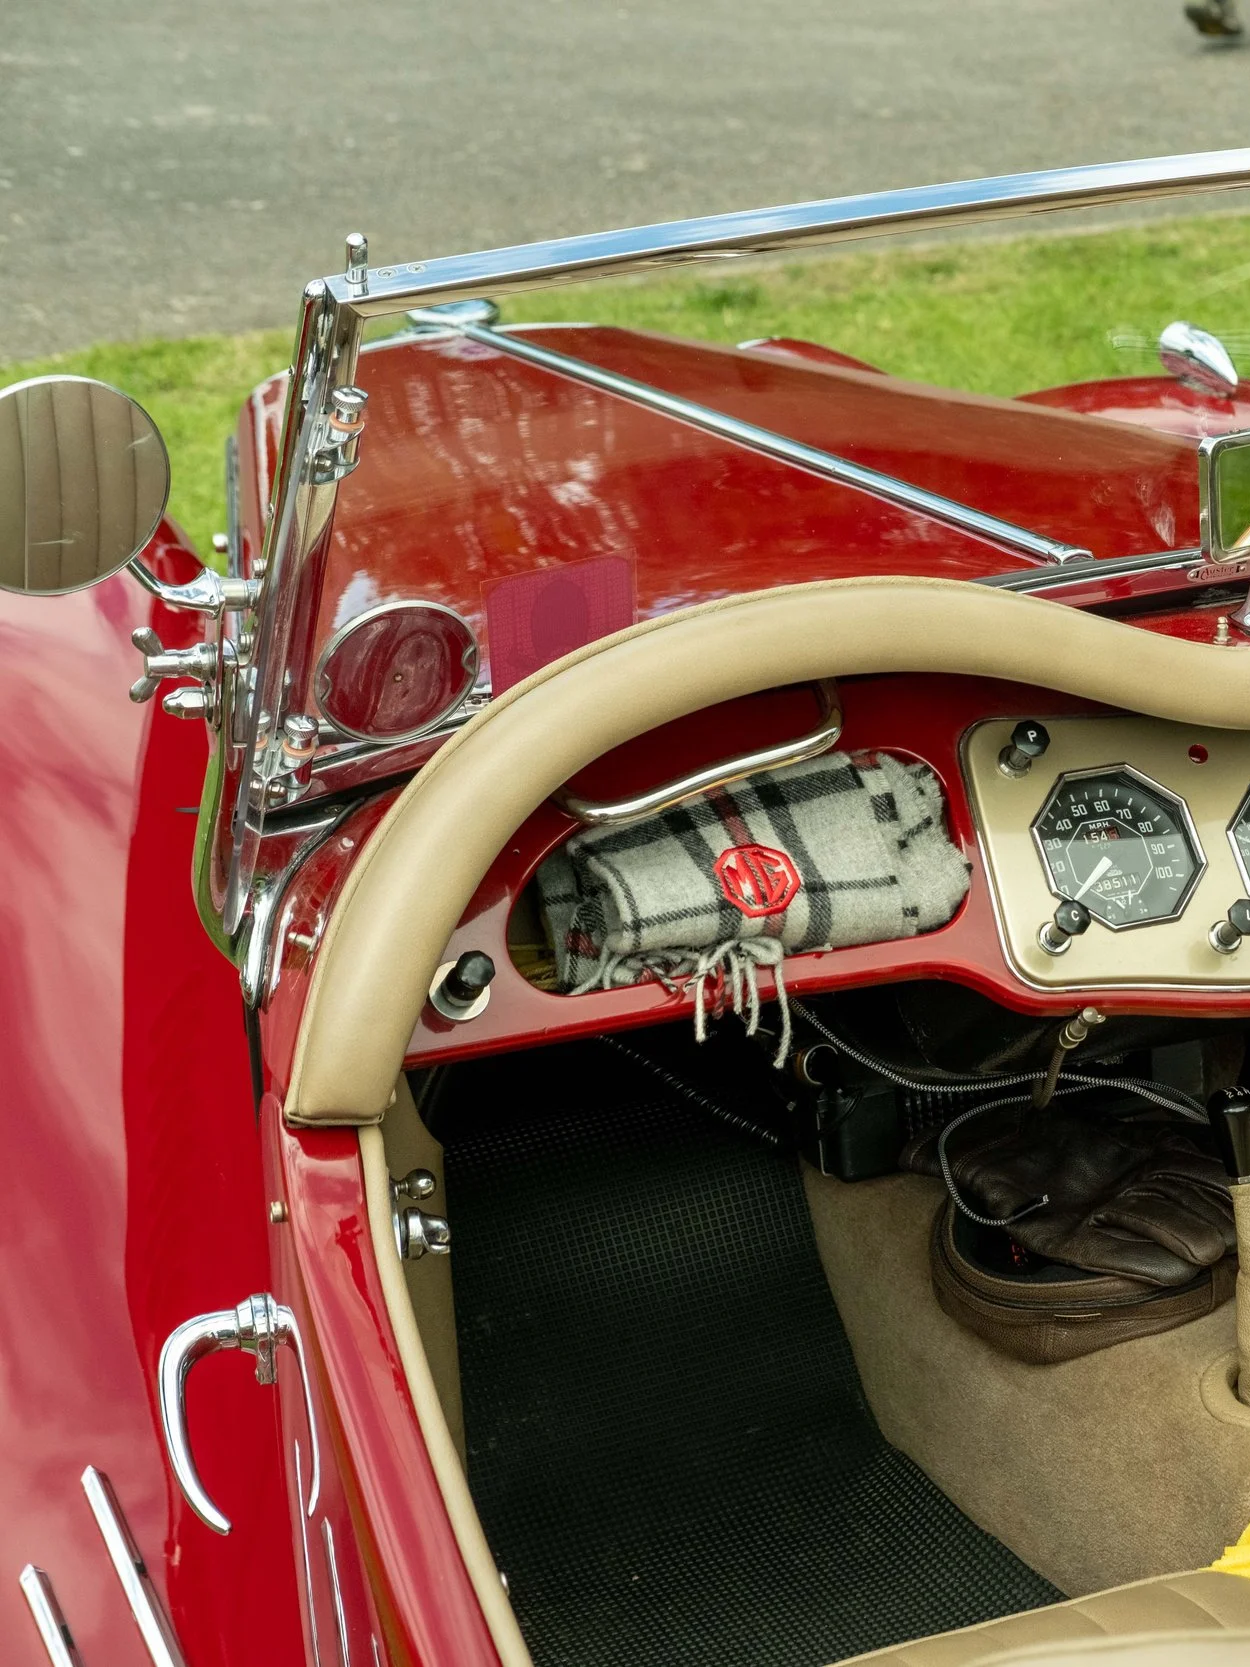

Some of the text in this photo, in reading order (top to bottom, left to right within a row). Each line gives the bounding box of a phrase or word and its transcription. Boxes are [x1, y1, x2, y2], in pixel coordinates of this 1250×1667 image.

[1027, 730, 1037, 743] P
[1071, 804, 1088, 817] 50
[1094, 800, 1110, 812] 60
[1116, 808, 1132, 820] 70
[1056, 818, 1072, 831] 40
[1138, 821, 1154, 833] 80
[1046, 838, 1062, 851] 30
[1151, 844, 1166, 855] 90
[725, 852, 790, 906] MG
[1156, 866, 1173, 880] 100
[1095, 874, 1137, 892] 38511
[1071, 910, 1080, 920] C
